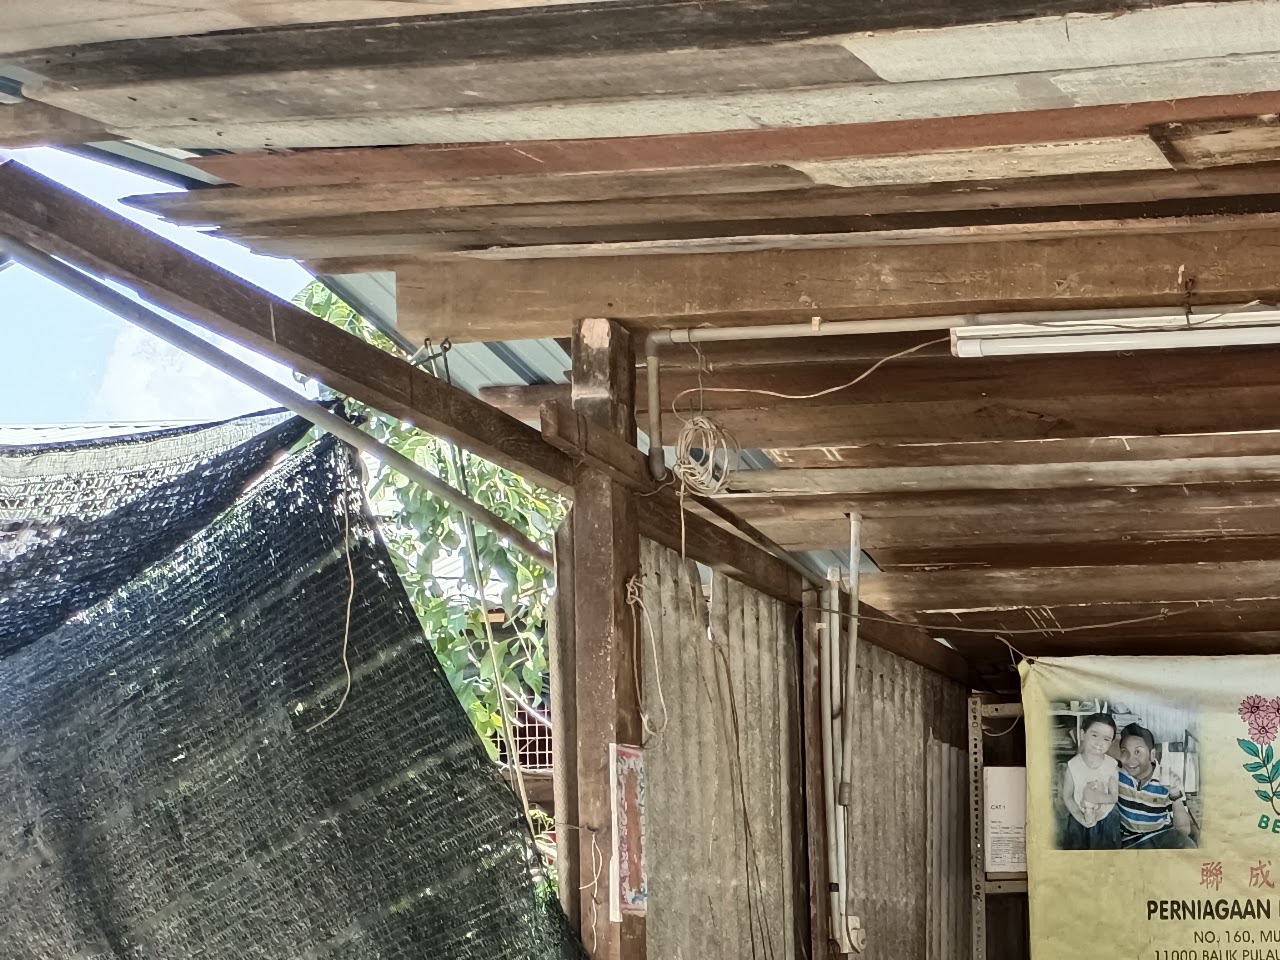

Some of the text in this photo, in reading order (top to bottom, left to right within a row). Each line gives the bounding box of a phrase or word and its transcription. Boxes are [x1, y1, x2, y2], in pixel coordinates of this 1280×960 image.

[1147, 898, 1271, 921] PERNIAGAAN
[1194, 931, 1219, 944] NO.
[1225, 930, 1255, 944] 160,
